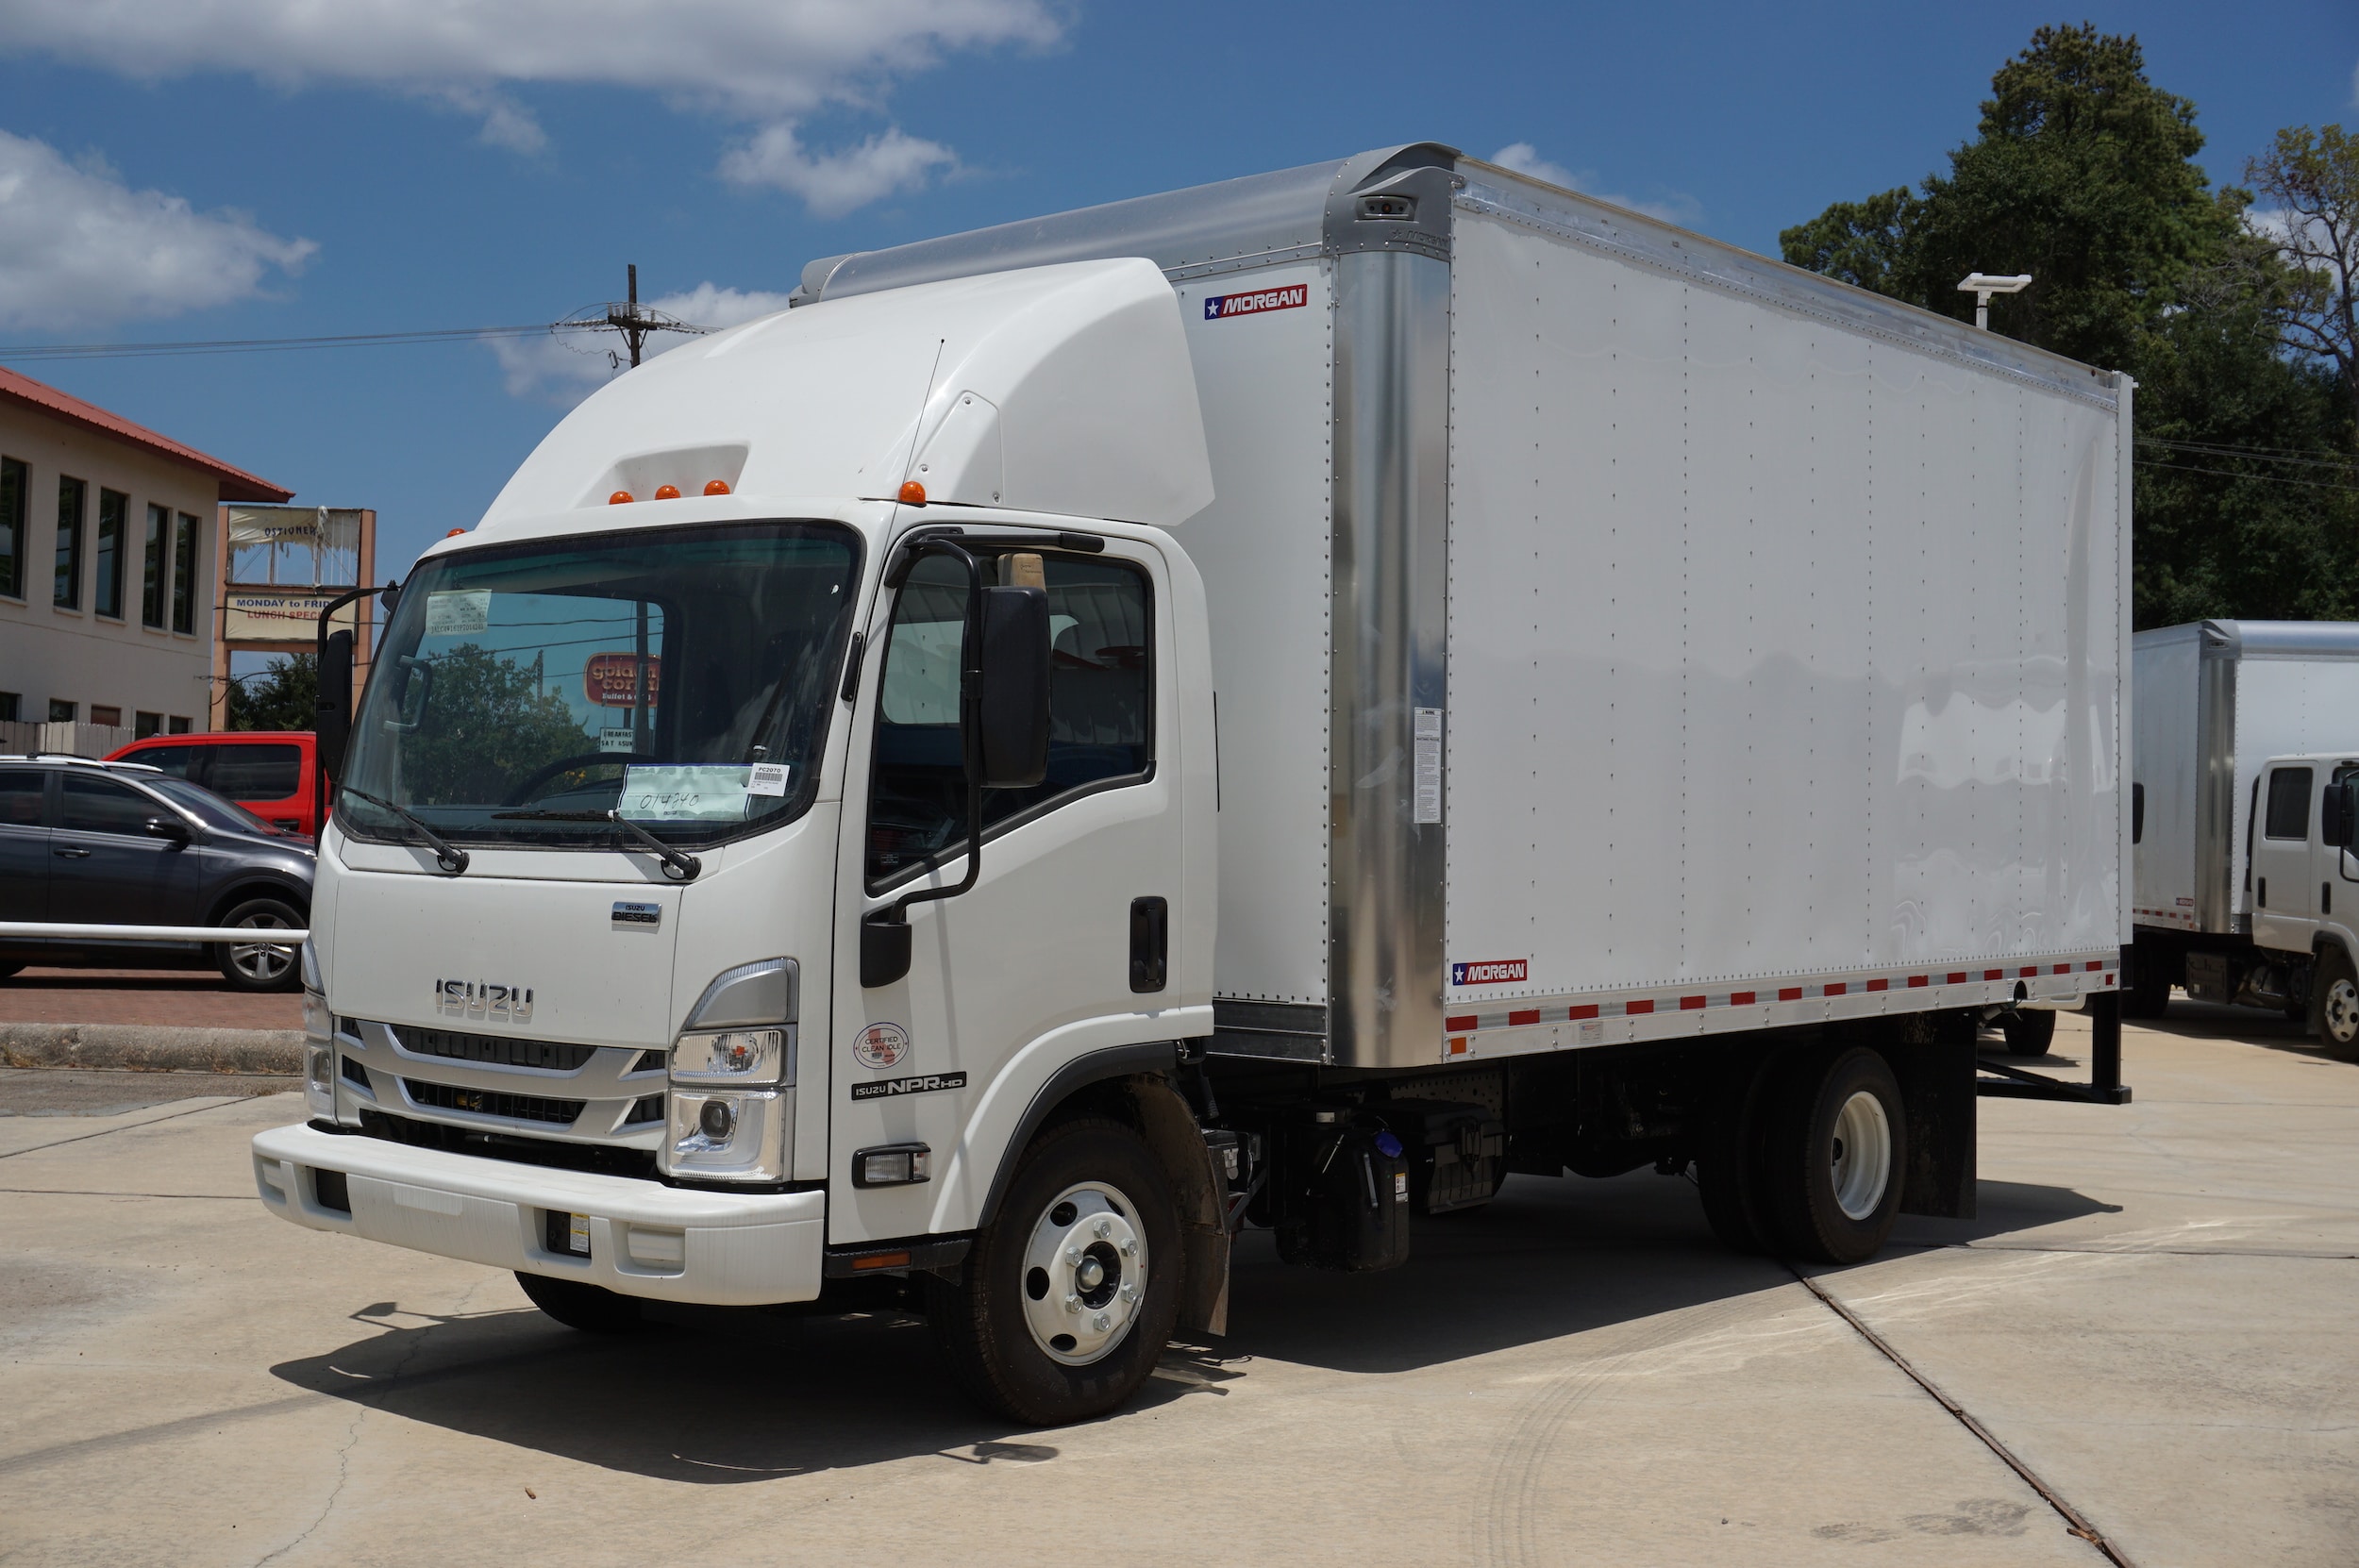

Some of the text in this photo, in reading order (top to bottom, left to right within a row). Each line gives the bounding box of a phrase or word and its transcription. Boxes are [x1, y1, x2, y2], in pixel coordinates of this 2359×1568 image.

[1223, 288, 1303, 314] MORGAN
[236, 599, 285, 608] MONDAY
[247, 610, 285, 620] LUNCH
[592, 664, 657, 679] goldn
[613, 911, 658, 924] DIESEL
[1467, 963, 1525, 981] MORGAN
[436, 977, 534, 1017] ISUZU
[864, 1036, 898, 1045] CERTIFIED
[856, 1085, 886, 1096] ISUZU
